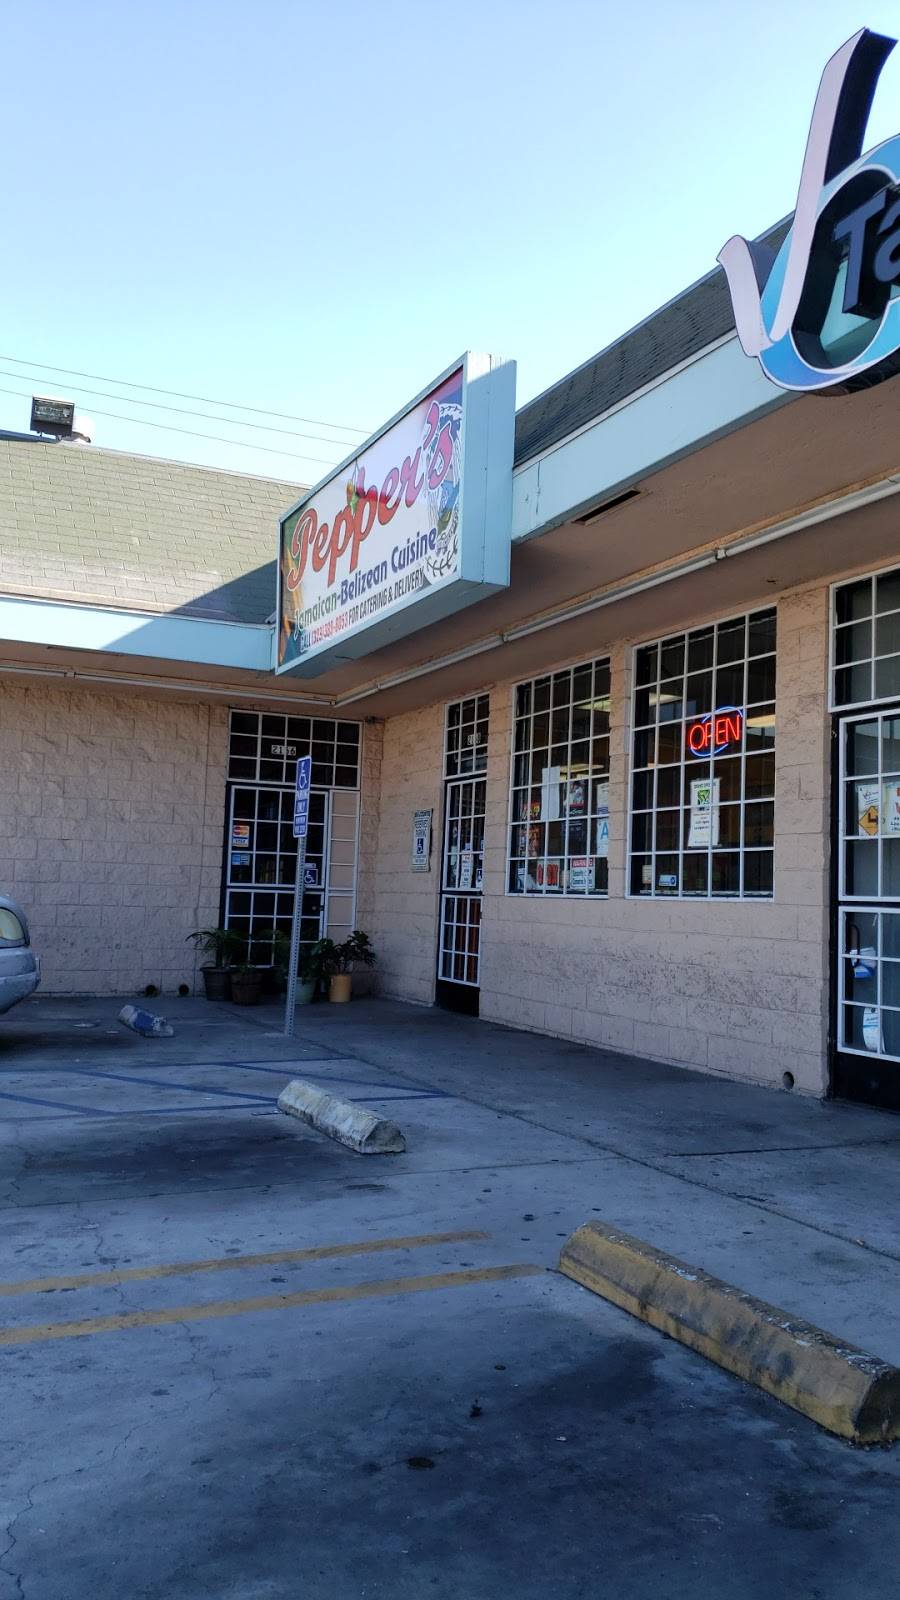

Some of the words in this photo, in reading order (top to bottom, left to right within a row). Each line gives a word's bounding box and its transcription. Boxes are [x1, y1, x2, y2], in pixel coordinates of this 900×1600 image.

[288, 401, 453, 590] Pepper's
[293, 560, 388, 640] Jamaican-Belizean
[391, 527, 437, 573] Cuisine
[349, 607, 360, 627] FOR
[360, 586, 388, 619] CATERING
[394, 566, 426, 600] DELIVERY
[690, 715, 741, 749] OPEN
